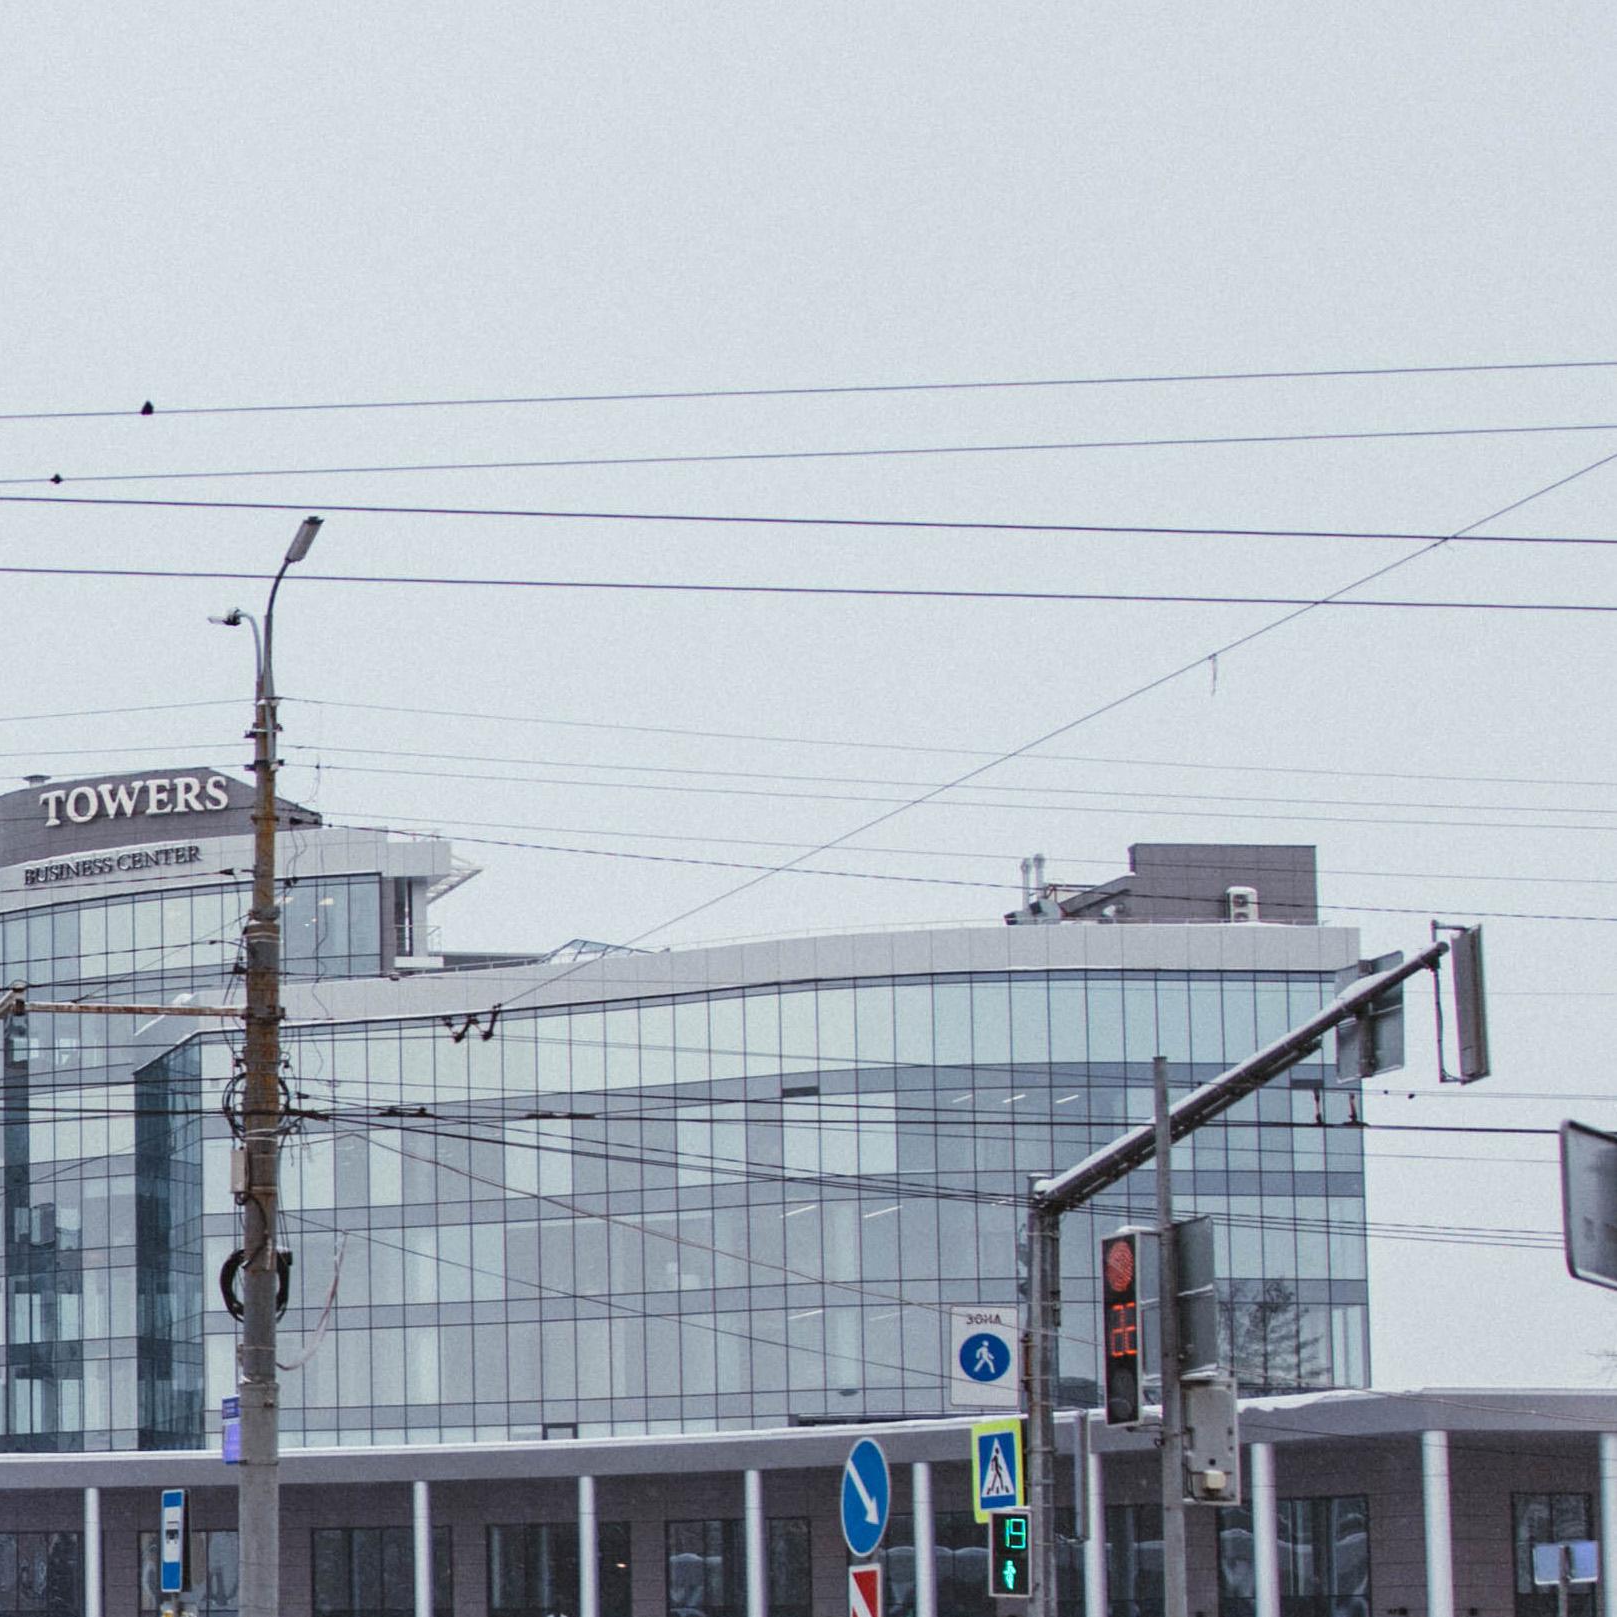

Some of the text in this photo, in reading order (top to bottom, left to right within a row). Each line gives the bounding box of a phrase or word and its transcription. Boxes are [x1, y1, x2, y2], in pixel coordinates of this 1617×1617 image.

[39, 775, 229, 827] TOWERS
[24, 845, 203, 885] BUSINESS CENTER
[966, 1313, 1002, 1325] ЗОНА
[1005, 1518, 1026, 1550] 19
